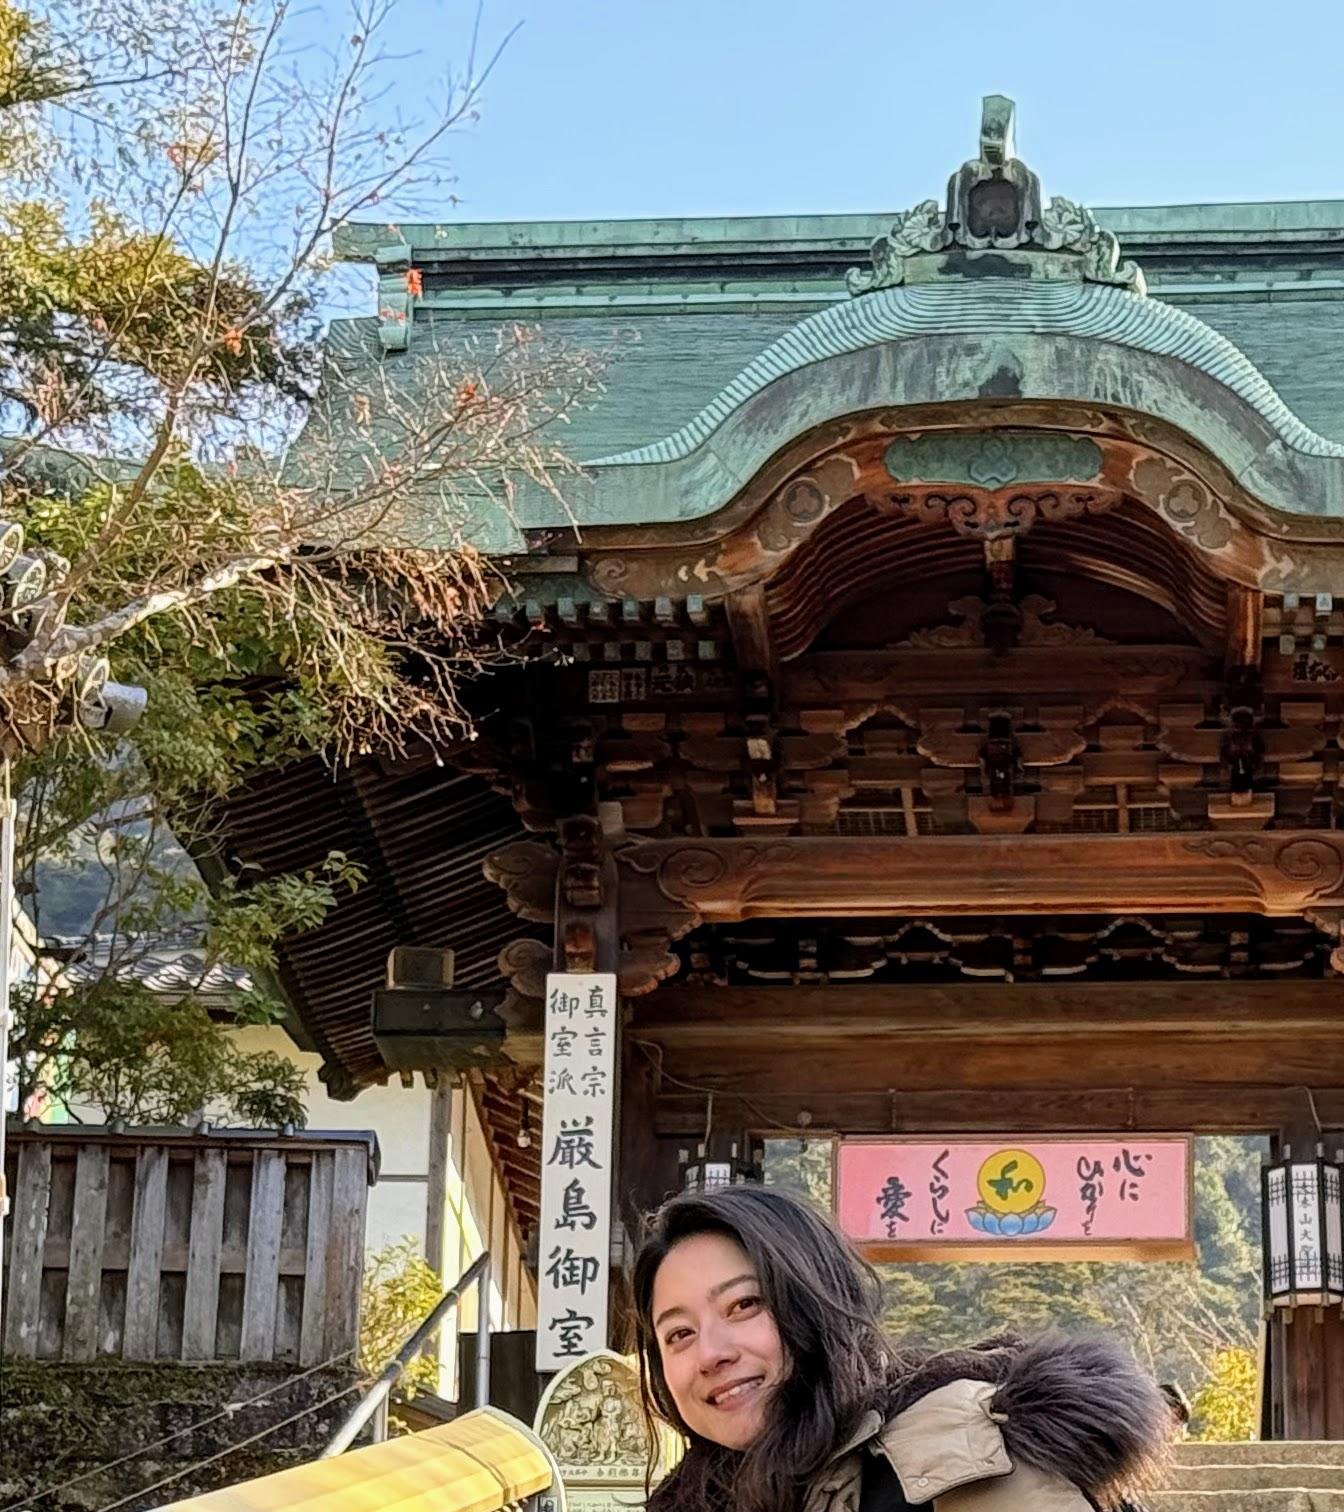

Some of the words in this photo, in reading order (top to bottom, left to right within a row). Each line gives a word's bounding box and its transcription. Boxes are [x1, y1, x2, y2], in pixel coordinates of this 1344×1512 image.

[548, 987, 581, 1096] 御室派
[581, 985, 608, 1097] 真言宗
[876, 1176, 913, 1238] 愛を
[929, 1149, 950, 1235] くらしに
[987, 1160, 1034, 1201] 和
[1077, 1156, 1105, 1236] ひかりを
[1113, 1149, 1153, 1202] 心に
[544, 1116, 603, 1358] 厳島御室
